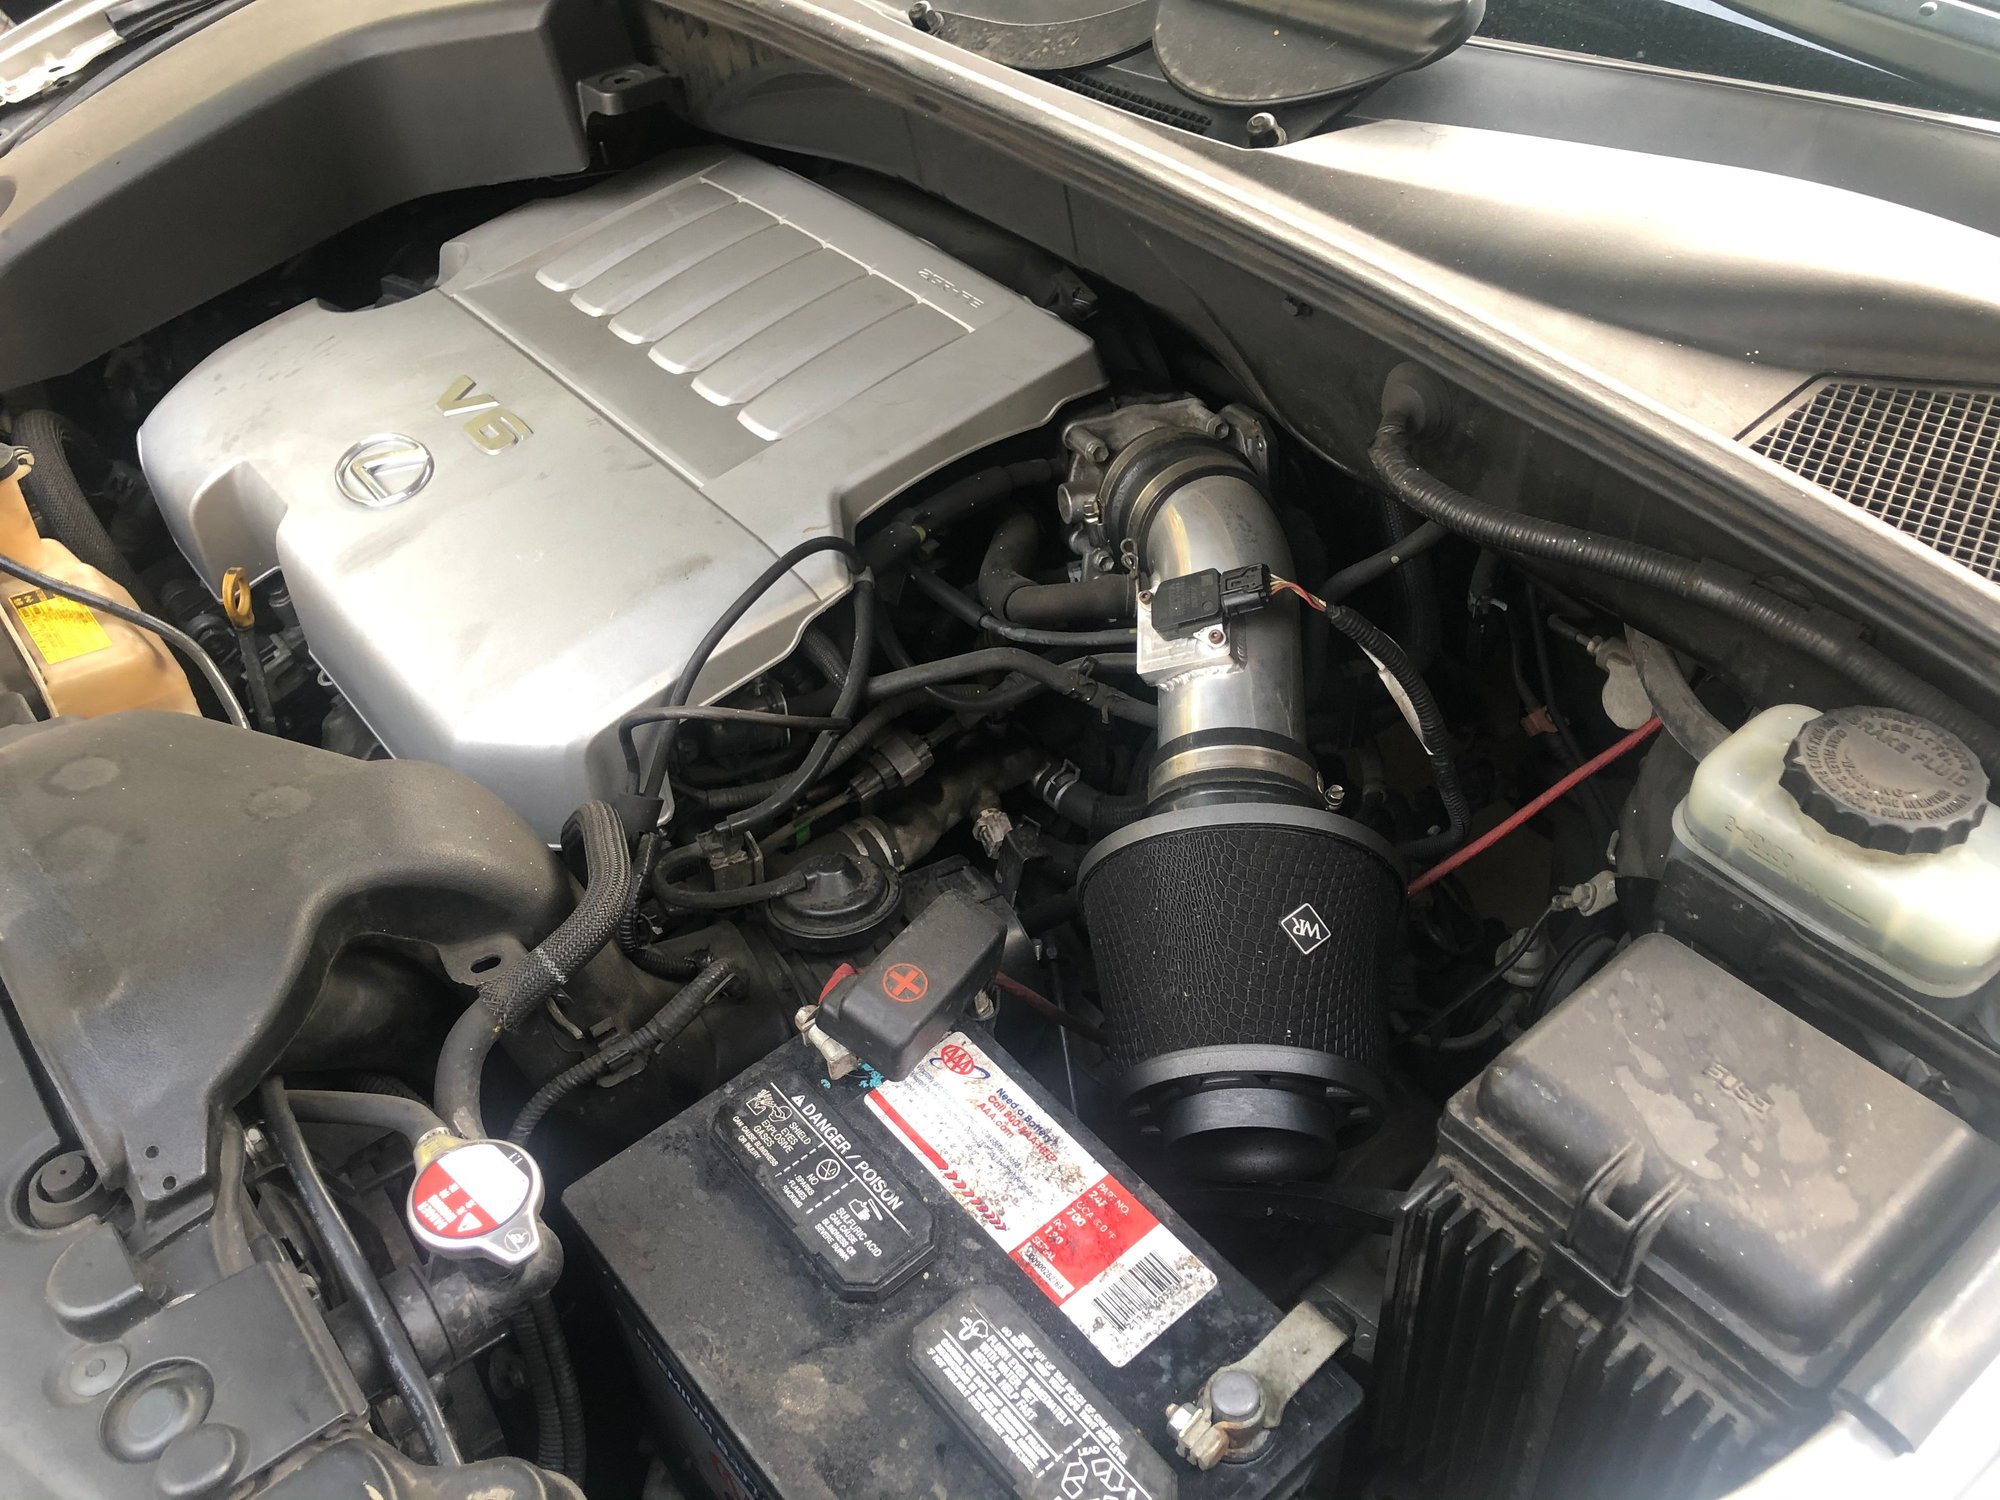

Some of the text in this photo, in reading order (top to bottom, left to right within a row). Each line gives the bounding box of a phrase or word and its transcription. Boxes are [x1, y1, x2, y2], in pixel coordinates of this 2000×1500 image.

[435, 374, 534, 455] V6
[1846, 715, 1911, 754] BRAKE
[1911, 751, 1970, 787] FLUID
[1292, 917, 1321, 940] WR
[942, 1045, 973, 1074] AAA
[987, 1094, 1005, 1111] Call
[997, 1088, 1017, 1108] Need
[978, 1102, 1013, 1137] AAA.com
[732, 1117, 778, 1165] CAN CAUSE BLINDNESS
[753, 1126, 773, 1146] GASES
[760, 1120, 792, 1152] EXPLOSIVE
[781, 1128, 797, 1144] EYES
[789, 1122, 810, 1143] SHIELD
[744, 1143, 760, 1159] INJURY
[801, 1104, 850, 1153] DANGER
[855, 1161, 902, 1209] POISON
[787, 1180, 806, 1199] FLAMES
[794, 1175, 814, 1195] SPARKS
[806, 1174, 818, 1184] NO
[780, 1186, 802, 1207] SMOKING
[1097, 1183, 1130, 1215] PART NO.
[1066, 1208, 1085, 1226] 700
[1076, 1201, 1094, 1218] CCA
[814, 1224, 833, 1243] SEVERE
[829, 1214, 857, 1243] CAN CAUSE
[835, 1208, 881, 1256] SULFURIC ACID
[1053, 1218, 1066, 1230] RC
[821, 1219, 855, 1255] BLINDNESS OR
[978, 1342, 998, 1362] WITH
[1020, 1388, 1037, 1405] GET
[986, 1335, 1073, 1427] FLUSH EYES IMMEDIATELY
[969, 1349, 1037, 1421] MEDICAL HELP FAST
[1077, 1445, 1100, 1457] LEAD
